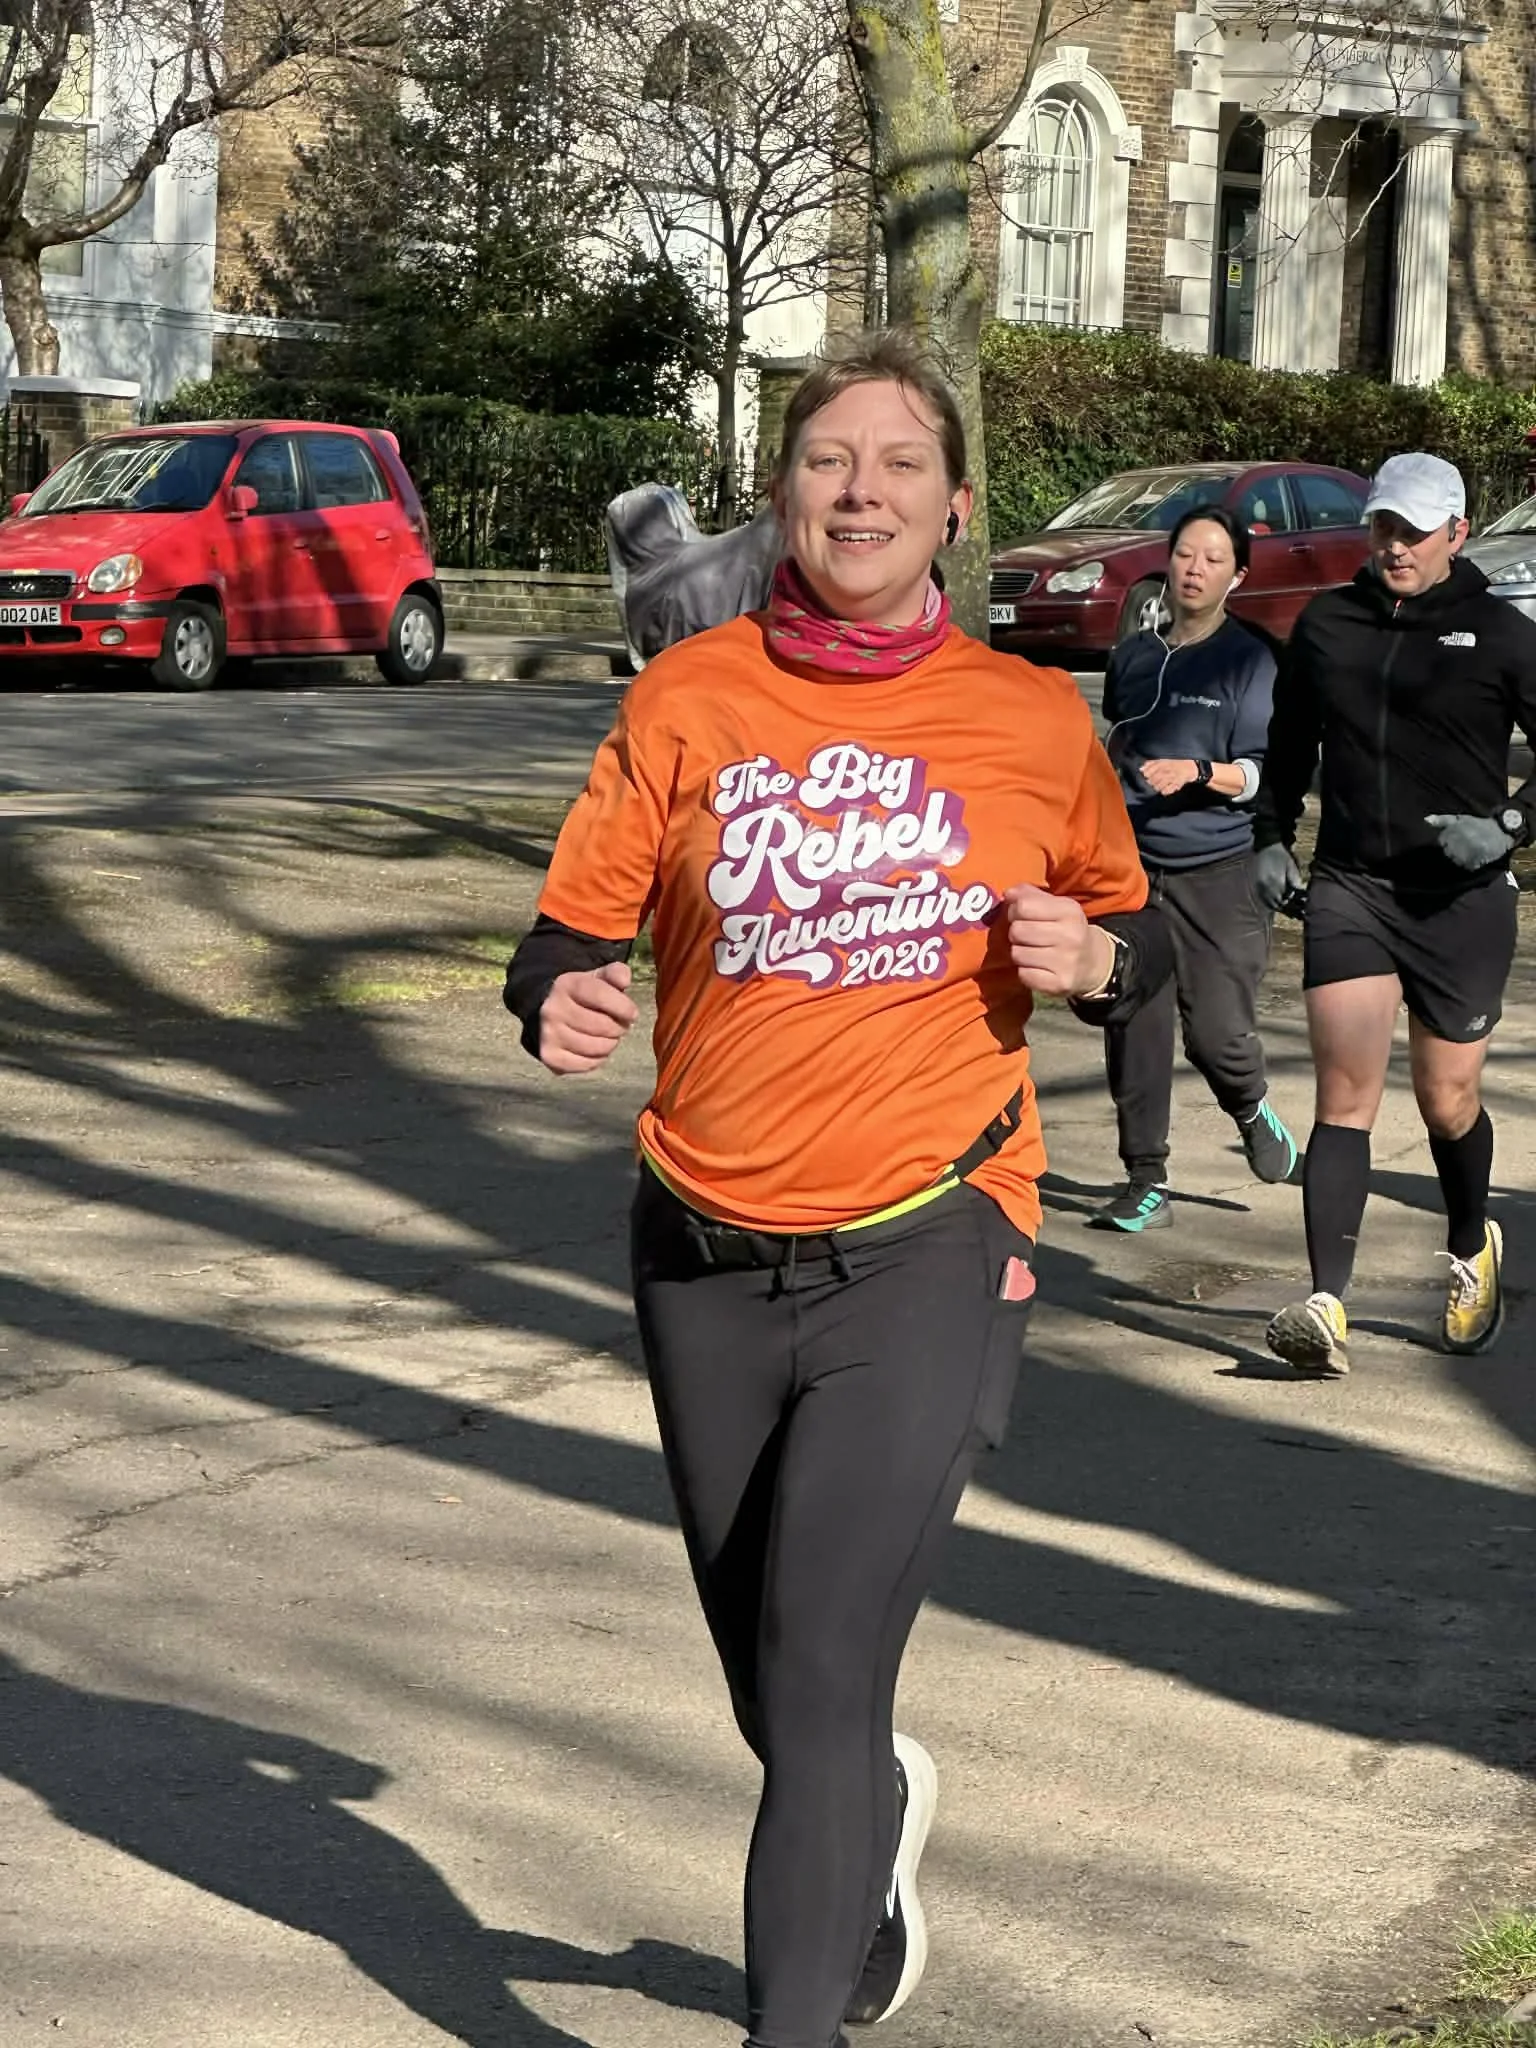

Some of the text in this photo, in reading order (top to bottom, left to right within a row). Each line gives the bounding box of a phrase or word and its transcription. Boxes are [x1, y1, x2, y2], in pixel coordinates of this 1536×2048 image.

[714, 743, 914, 815] The Big
[708, 792, 952, 911] Rebel
[715, 871, 993, 983] Adventure
[840, 937, 944, 988] 2026
